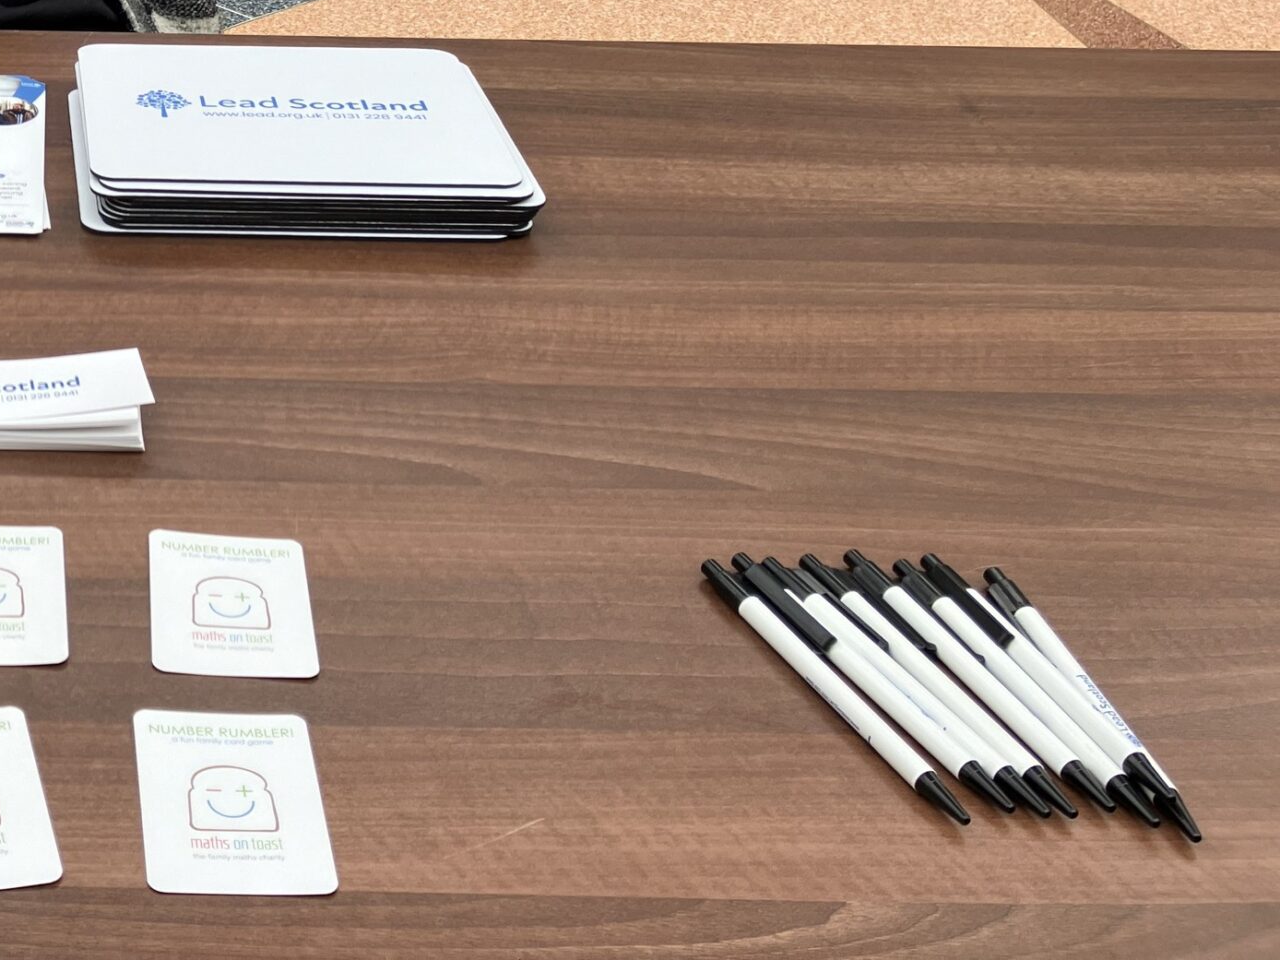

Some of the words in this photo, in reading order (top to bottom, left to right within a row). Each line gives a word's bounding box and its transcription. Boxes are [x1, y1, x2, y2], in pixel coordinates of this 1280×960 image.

[199, 95, 278, 109] Lead
[288, 98, 428, 112] Scotland
[202, 111, 322, 120] www.lead.org.uk
[161, 541, 219, 555] NUMBER
[223, 545, 291, 559] RUMBLER!
[192, 629, 226, 642] maths
[229, 632, 243, 643] on
[245, 632, 273, 644] toast
[1075, 674, 1111, 709] Scotland
[1102, 710, 1128, 731] Lead
[148, 724, 213, 736] NUMBER
[218, 727, 294, 739] RUMBLER!
[190, 836, 230, 850] maths
[234, 839, 249, 850] on
[251, 837, 284, 850] toast
